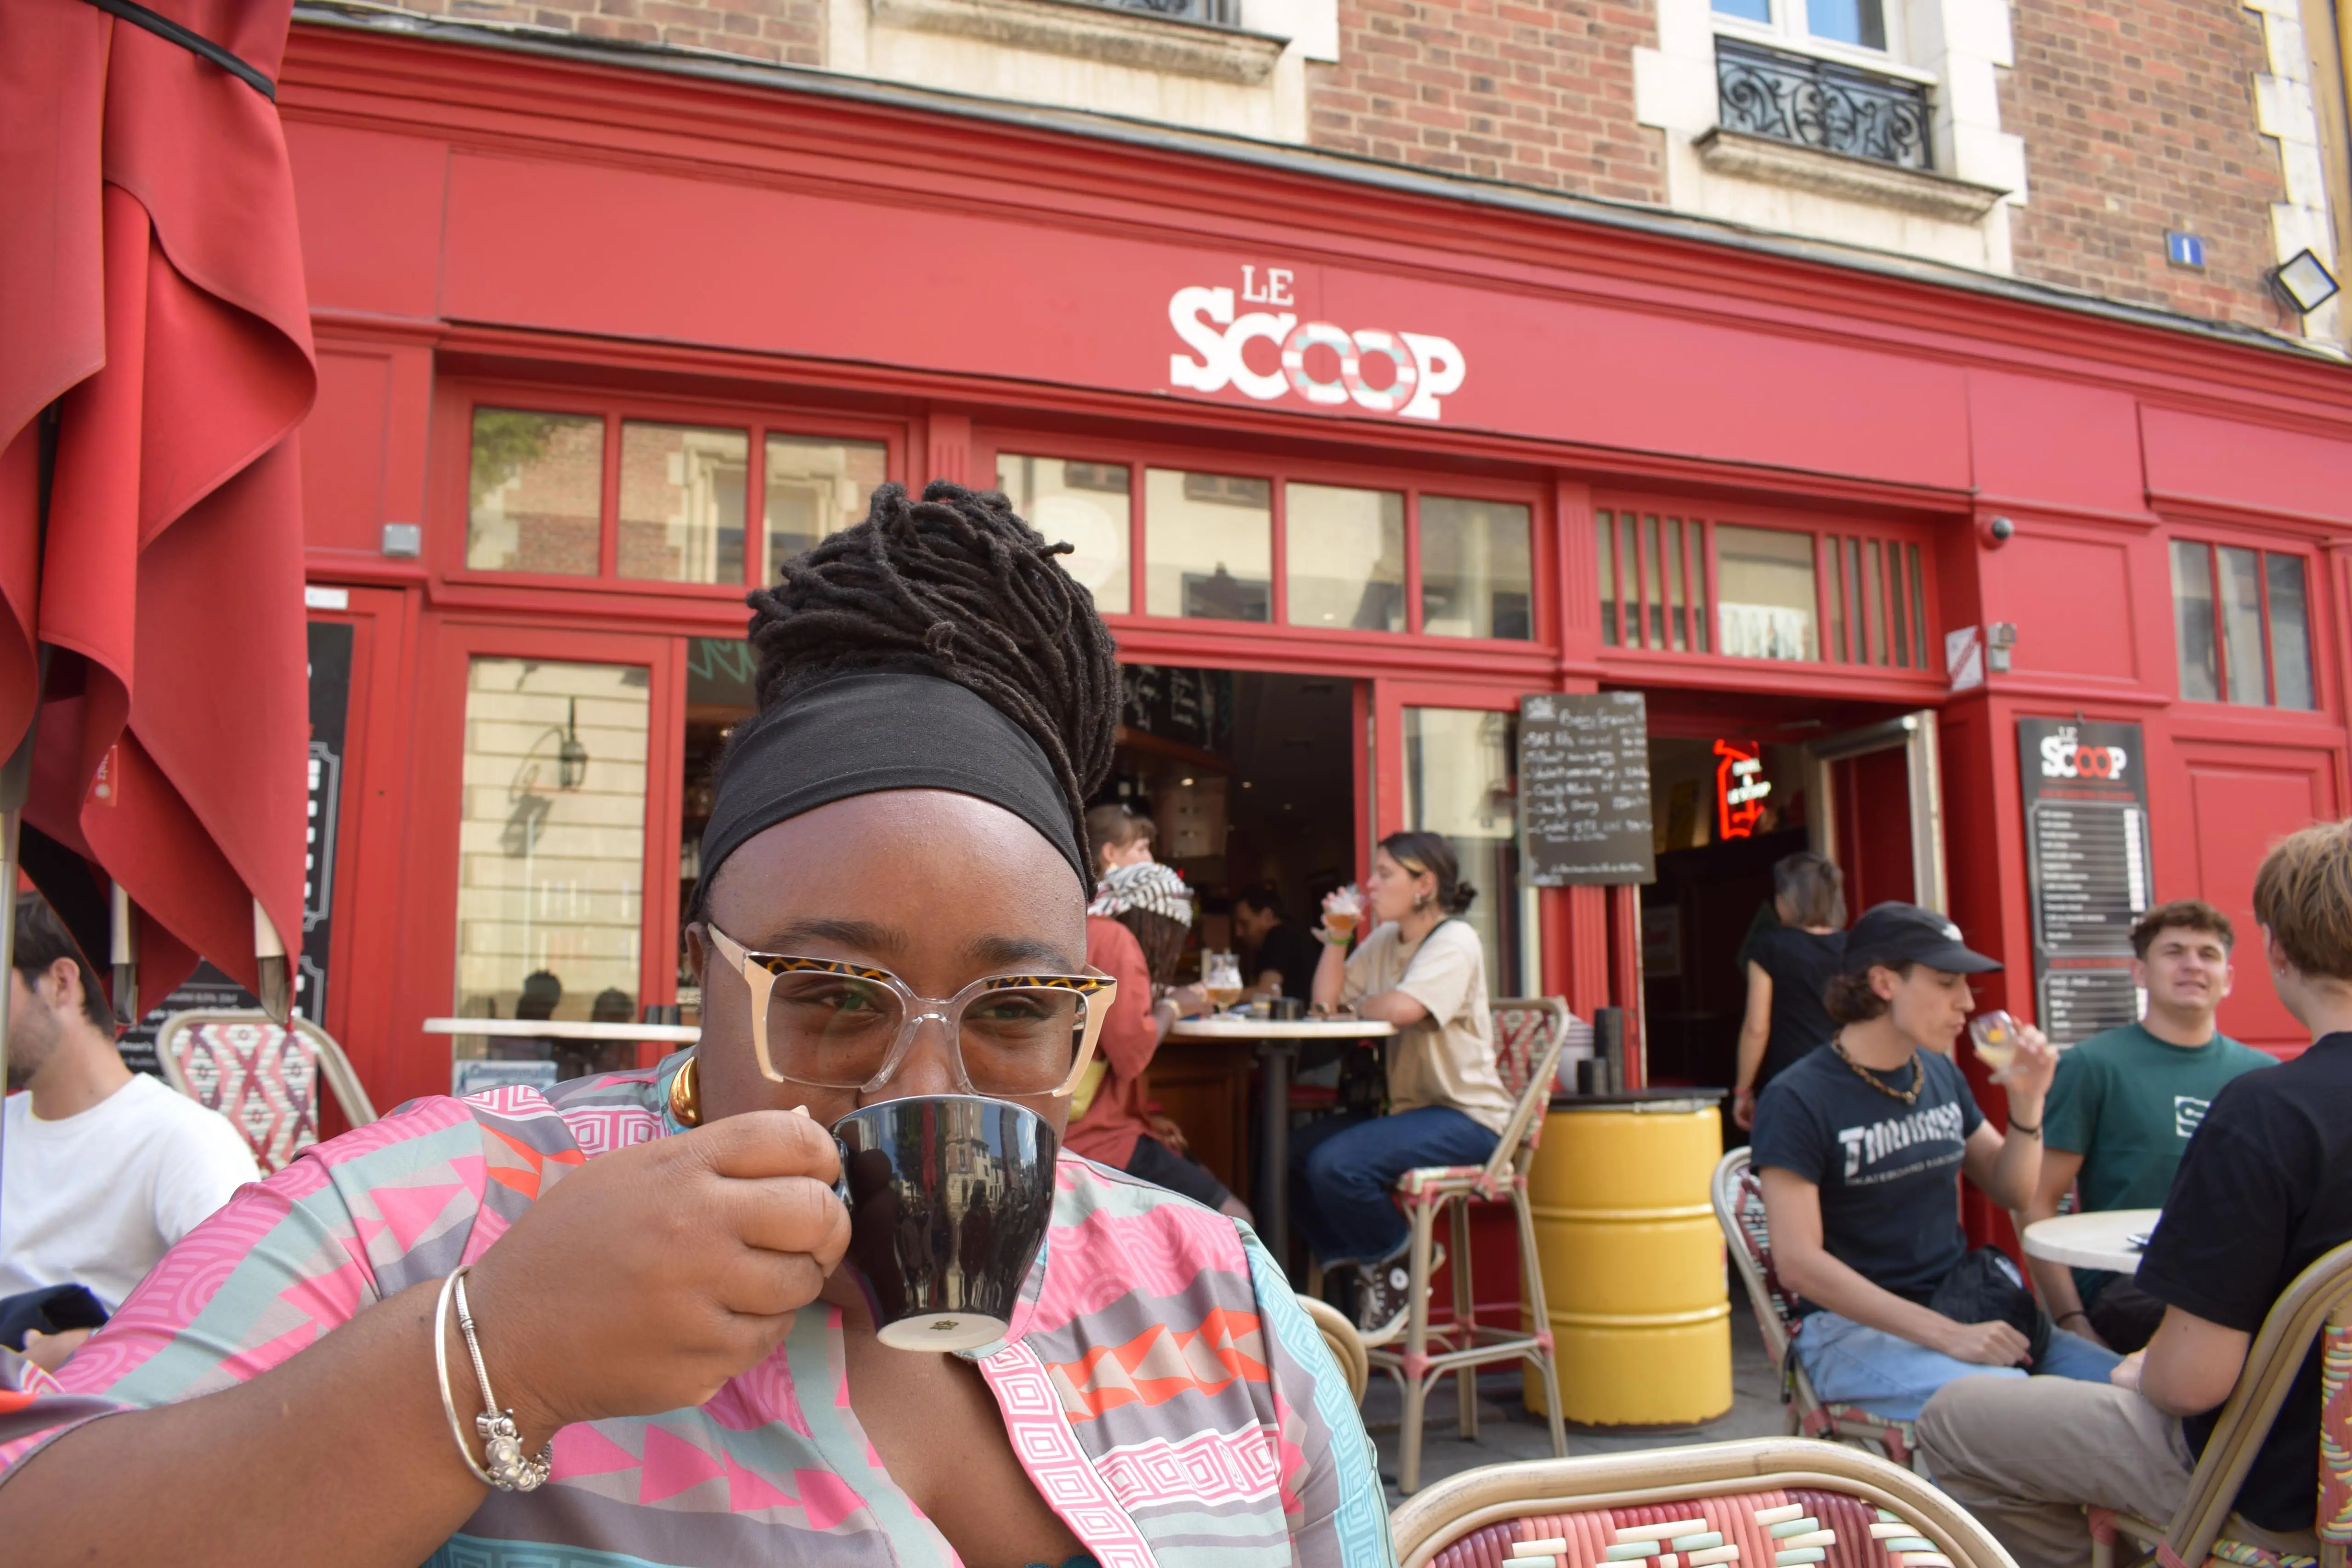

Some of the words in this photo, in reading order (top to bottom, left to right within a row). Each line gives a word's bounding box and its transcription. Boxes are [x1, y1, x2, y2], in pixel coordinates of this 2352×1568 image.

[2182, 237, 2192, 264] 1
[1241, 265, 1294, 306] LE
[1168, 286, 1466, 421] SCOOP
[2040, 735, 2127, 780] SCOOP
